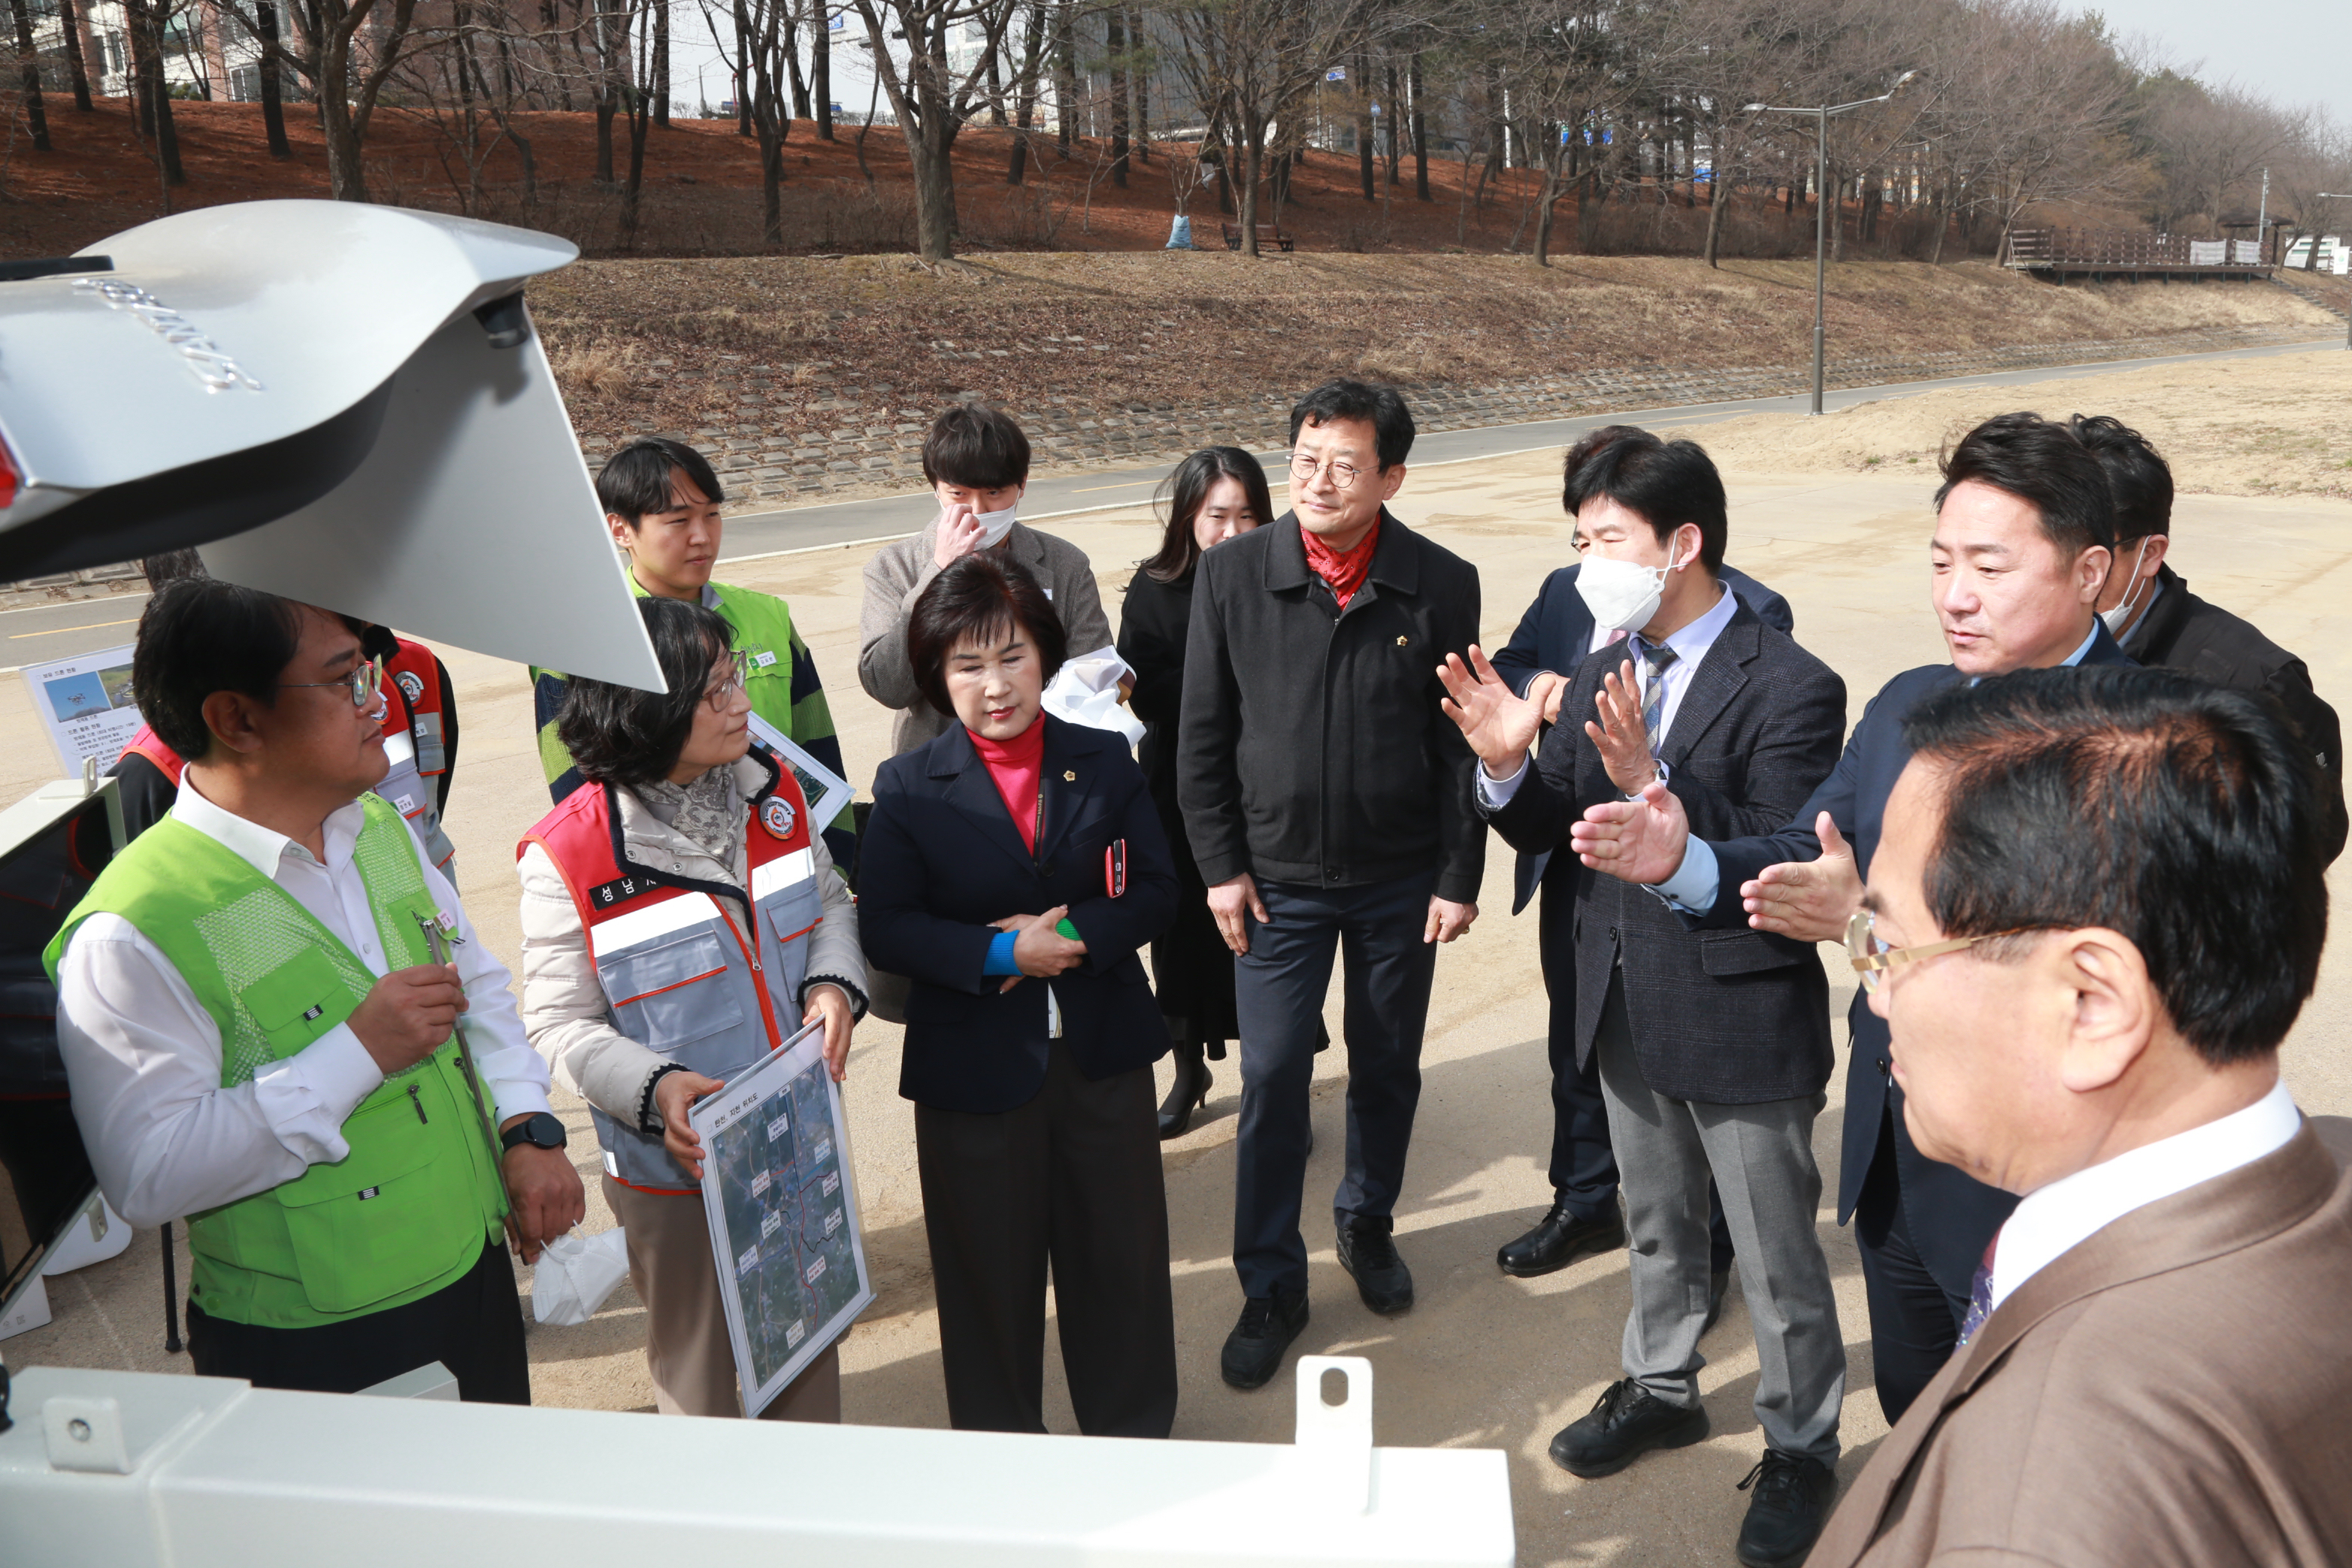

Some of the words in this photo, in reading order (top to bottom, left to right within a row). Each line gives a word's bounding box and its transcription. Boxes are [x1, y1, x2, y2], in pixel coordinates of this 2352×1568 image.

[714, 1115, 728, 1128] 탄천,
[730, 1104, 740, 1116] 지천
[742, 1092, 758, 1108] 위치도
